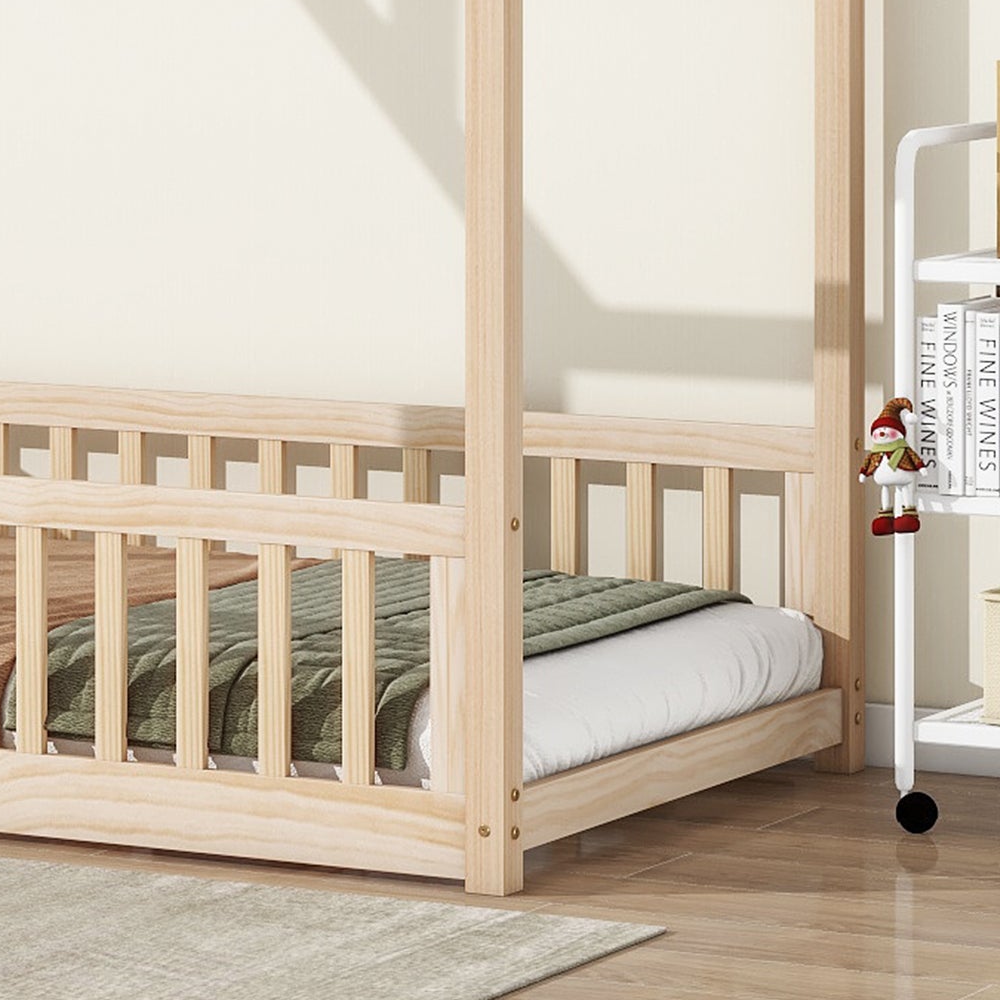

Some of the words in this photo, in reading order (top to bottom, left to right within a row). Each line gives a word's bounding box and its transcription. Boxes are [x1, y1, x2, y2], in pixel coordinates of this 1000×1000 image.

[920, 341, 937, 388] FINE
[943, 311, 958, 388] WINDOWS
[979, 338, 996, 387] FINE
[920, 398, 937, 469] WINES
[979, 398, 996, 472] WINES
